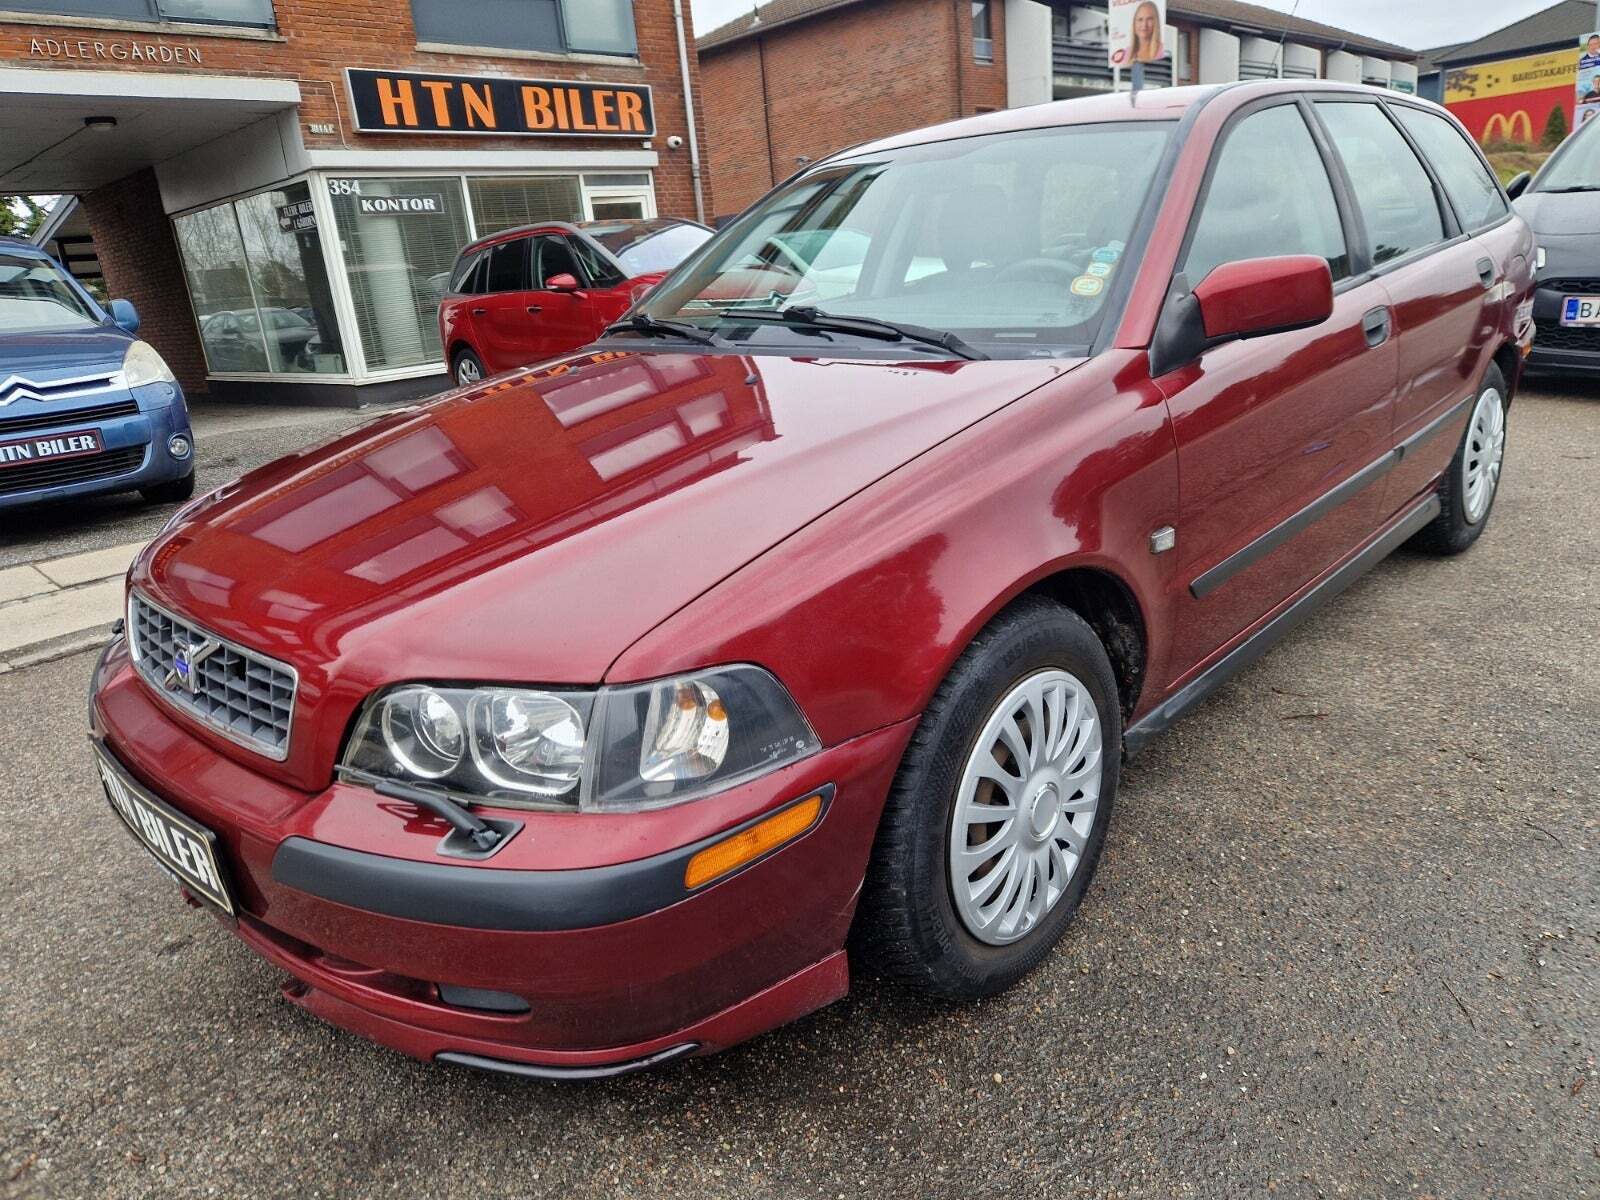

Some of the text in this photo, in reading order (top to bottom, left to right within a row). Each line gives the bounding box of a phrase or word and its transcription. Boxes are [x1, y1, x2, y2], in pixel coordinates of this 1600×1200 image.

[29, 38, 202, 64] ADLERGÅRDEN
[376, 78, 646, 132] HTN BILER
[328, 179, 363, 196] 384
[361, 197, 436, 212] KONTOR
[36, 435, 97, 457] BILER
[133, 798, 220, 893] BILER
